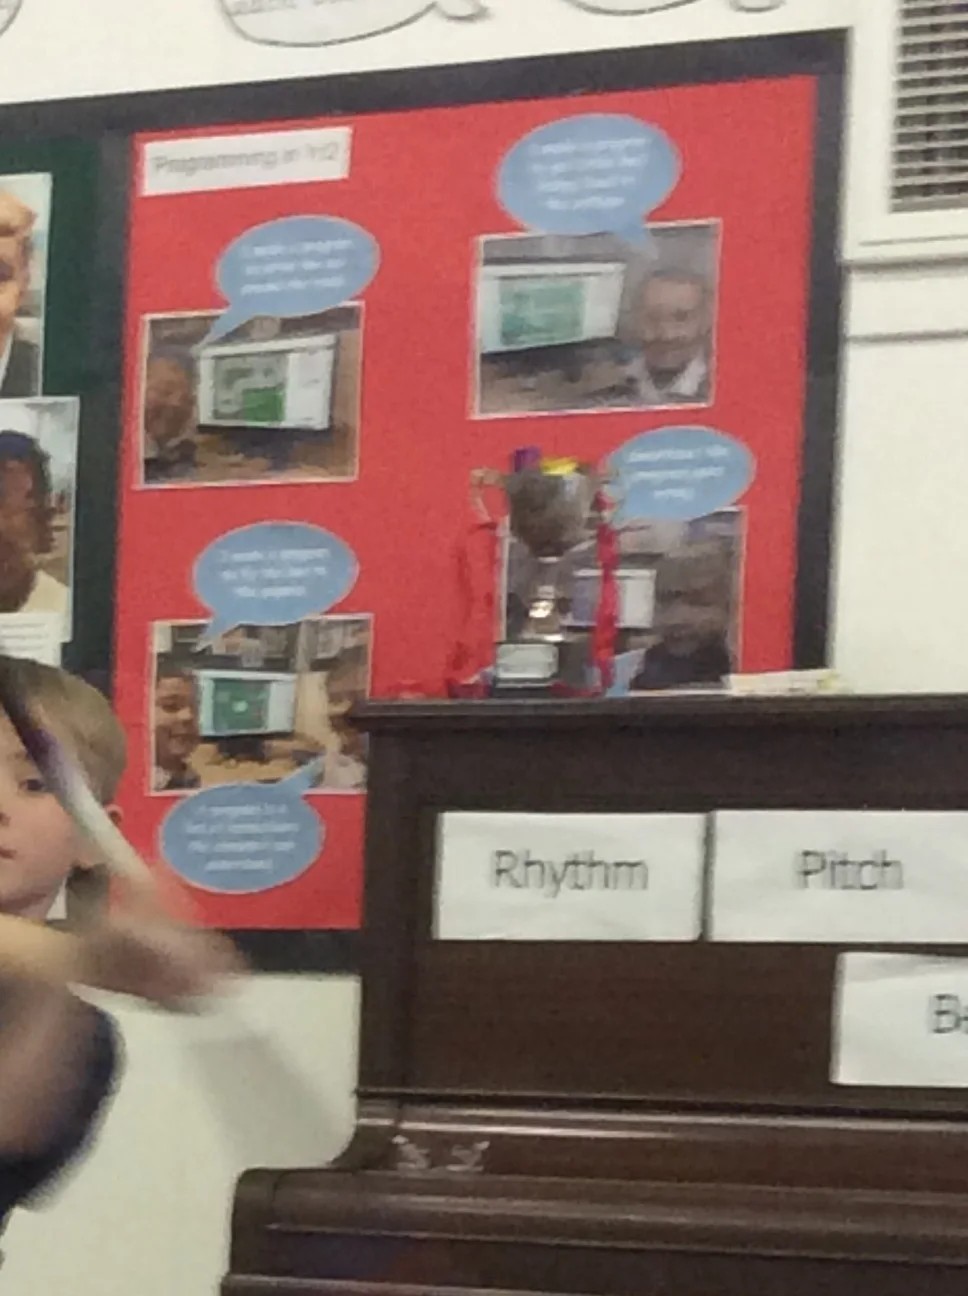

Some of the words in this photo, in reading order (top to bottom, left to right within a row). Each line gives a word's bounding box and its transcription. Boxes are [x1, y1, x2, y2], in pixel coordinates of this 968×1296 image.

[493, 849, 649, 898] Rhythm
[795, 849, 904, 891] Pitch
[929, 994, 968, 1034] B
